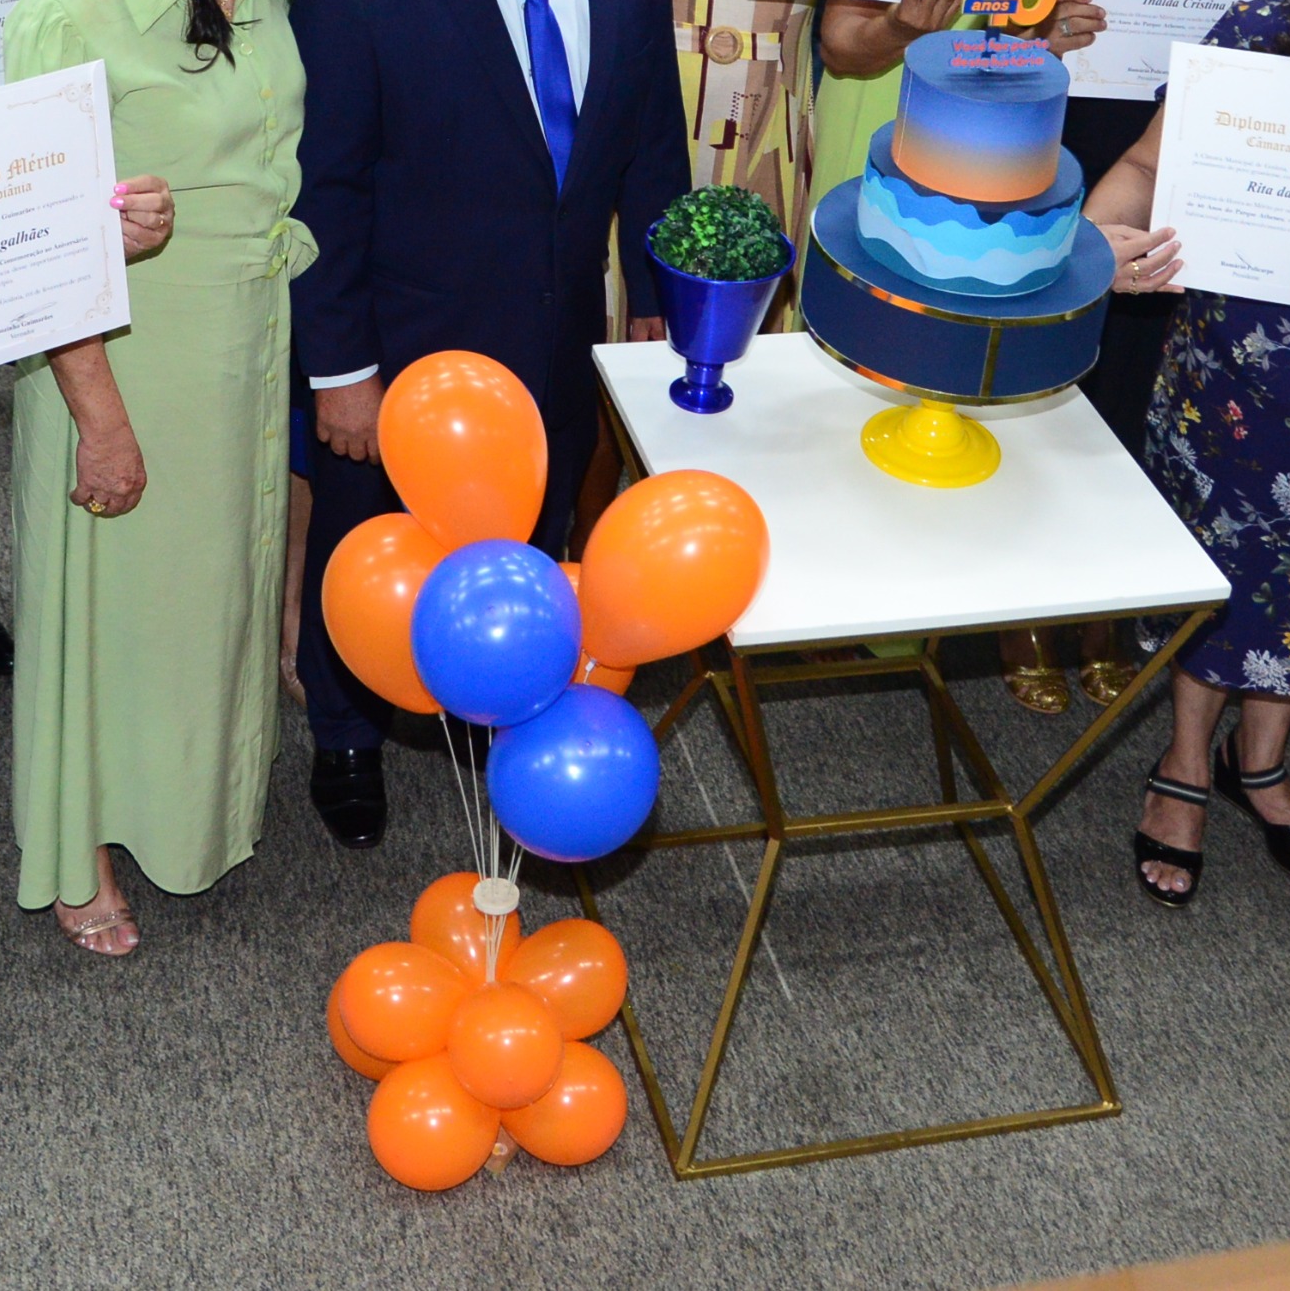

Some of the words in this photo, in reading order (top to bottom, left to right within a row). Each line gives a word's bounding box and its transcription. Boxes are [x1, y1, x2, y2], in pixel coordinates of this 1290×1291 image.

[971, 0, 1010, 12] anos
[6, 151, 65, 180] Mérito
[1246, 180, 1273, 195] Rita
